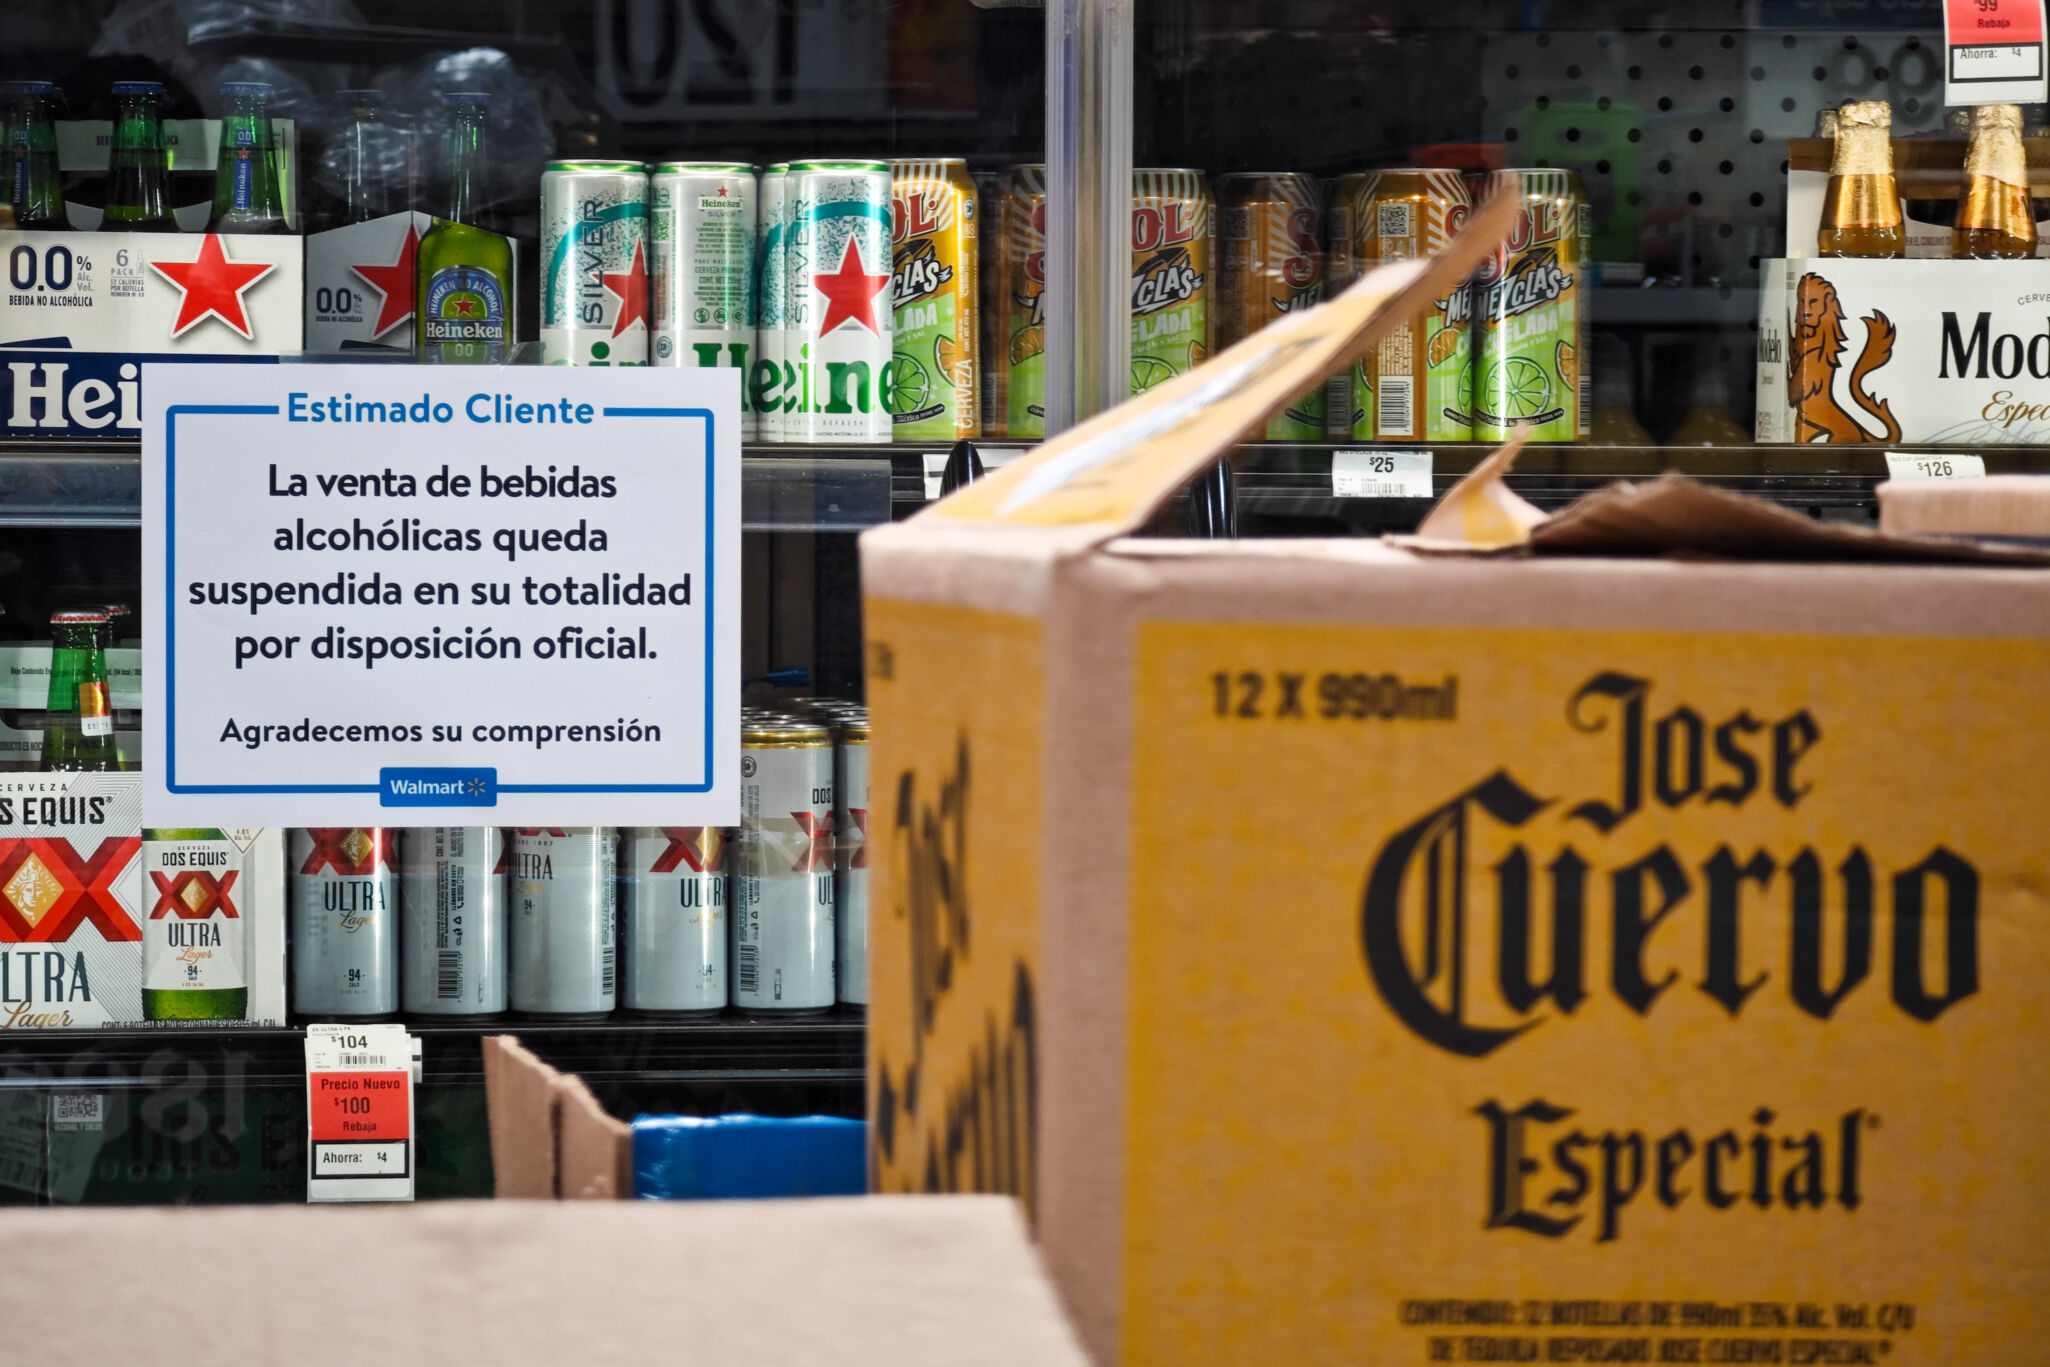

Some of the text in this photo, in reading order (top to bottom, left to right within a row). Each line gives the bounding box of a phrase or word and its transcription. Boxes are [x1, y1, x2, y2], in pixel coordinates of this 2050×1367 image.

[1978, 19, 2011, 29] Rebaja
[1960, 47, 2021, 59] Ahorra: $4
[701, 199, 741, 209] Heineken
[116, 248, 128, 266] 6
[583, 200, 603, 323] SILVER
[795, 199, 809, 324] SILVER
[10, 245, 72, 291] 0.0
[111, 268, 134, 276] PACK
[9, 292, 93, 307] BEBIDA NO ALCOHÓLICA
[316, 287, 351, 314] 0.0
[426, 322, 503, 339] Heineken
[957, 359, 973, 429] CERVEZA
[288, 392, 595, 425] Estimado Cliente
[1369, 456, 1394, 473] $25
[1917, 461, 1953, 477] $126
[269, 463, 618, 499] La venta de bebidas
[273, 517, 608, 562] alcohólicas queda
[188, 571, 691, 615] suspendida en su totalidad
[235, 625, 658, 669] por disposición oficial.
[1209, 671, 1459, 722] 12 X 990ml
[219, 717, 662, 750] Agradecemos su comprensión
[1565, 670, 1822, 836] Jose
[390, 780, 464, 795] Walmart
[813, 788, 831, 804] DOS
[162, 851, 227, 867] DOS EQUIS
[149, 870, 240, 919] XX
[324, 881, 386, 912] ULTRA
[1361, 766, 1982, 1060] Cuervo
[168, 923, 222, 948] ULTRA
[176, 946, 214, 965] Lager
[187, 965, 198, 977] 94
[348, 968, 361, 982] 94
[0, 1001, 73, 1030] Lager
[331, 1035, 368, 1049] $104
[321, 1078, 400, 1090] Precio Nuevo
[334, 1096, 371, 1115] $100
[342, 1120, 377, 1133] Rebaja
[323, 1152, 387, 1163] Ahorra: $4
[1473, 1099, 1866, 1245] Especial
